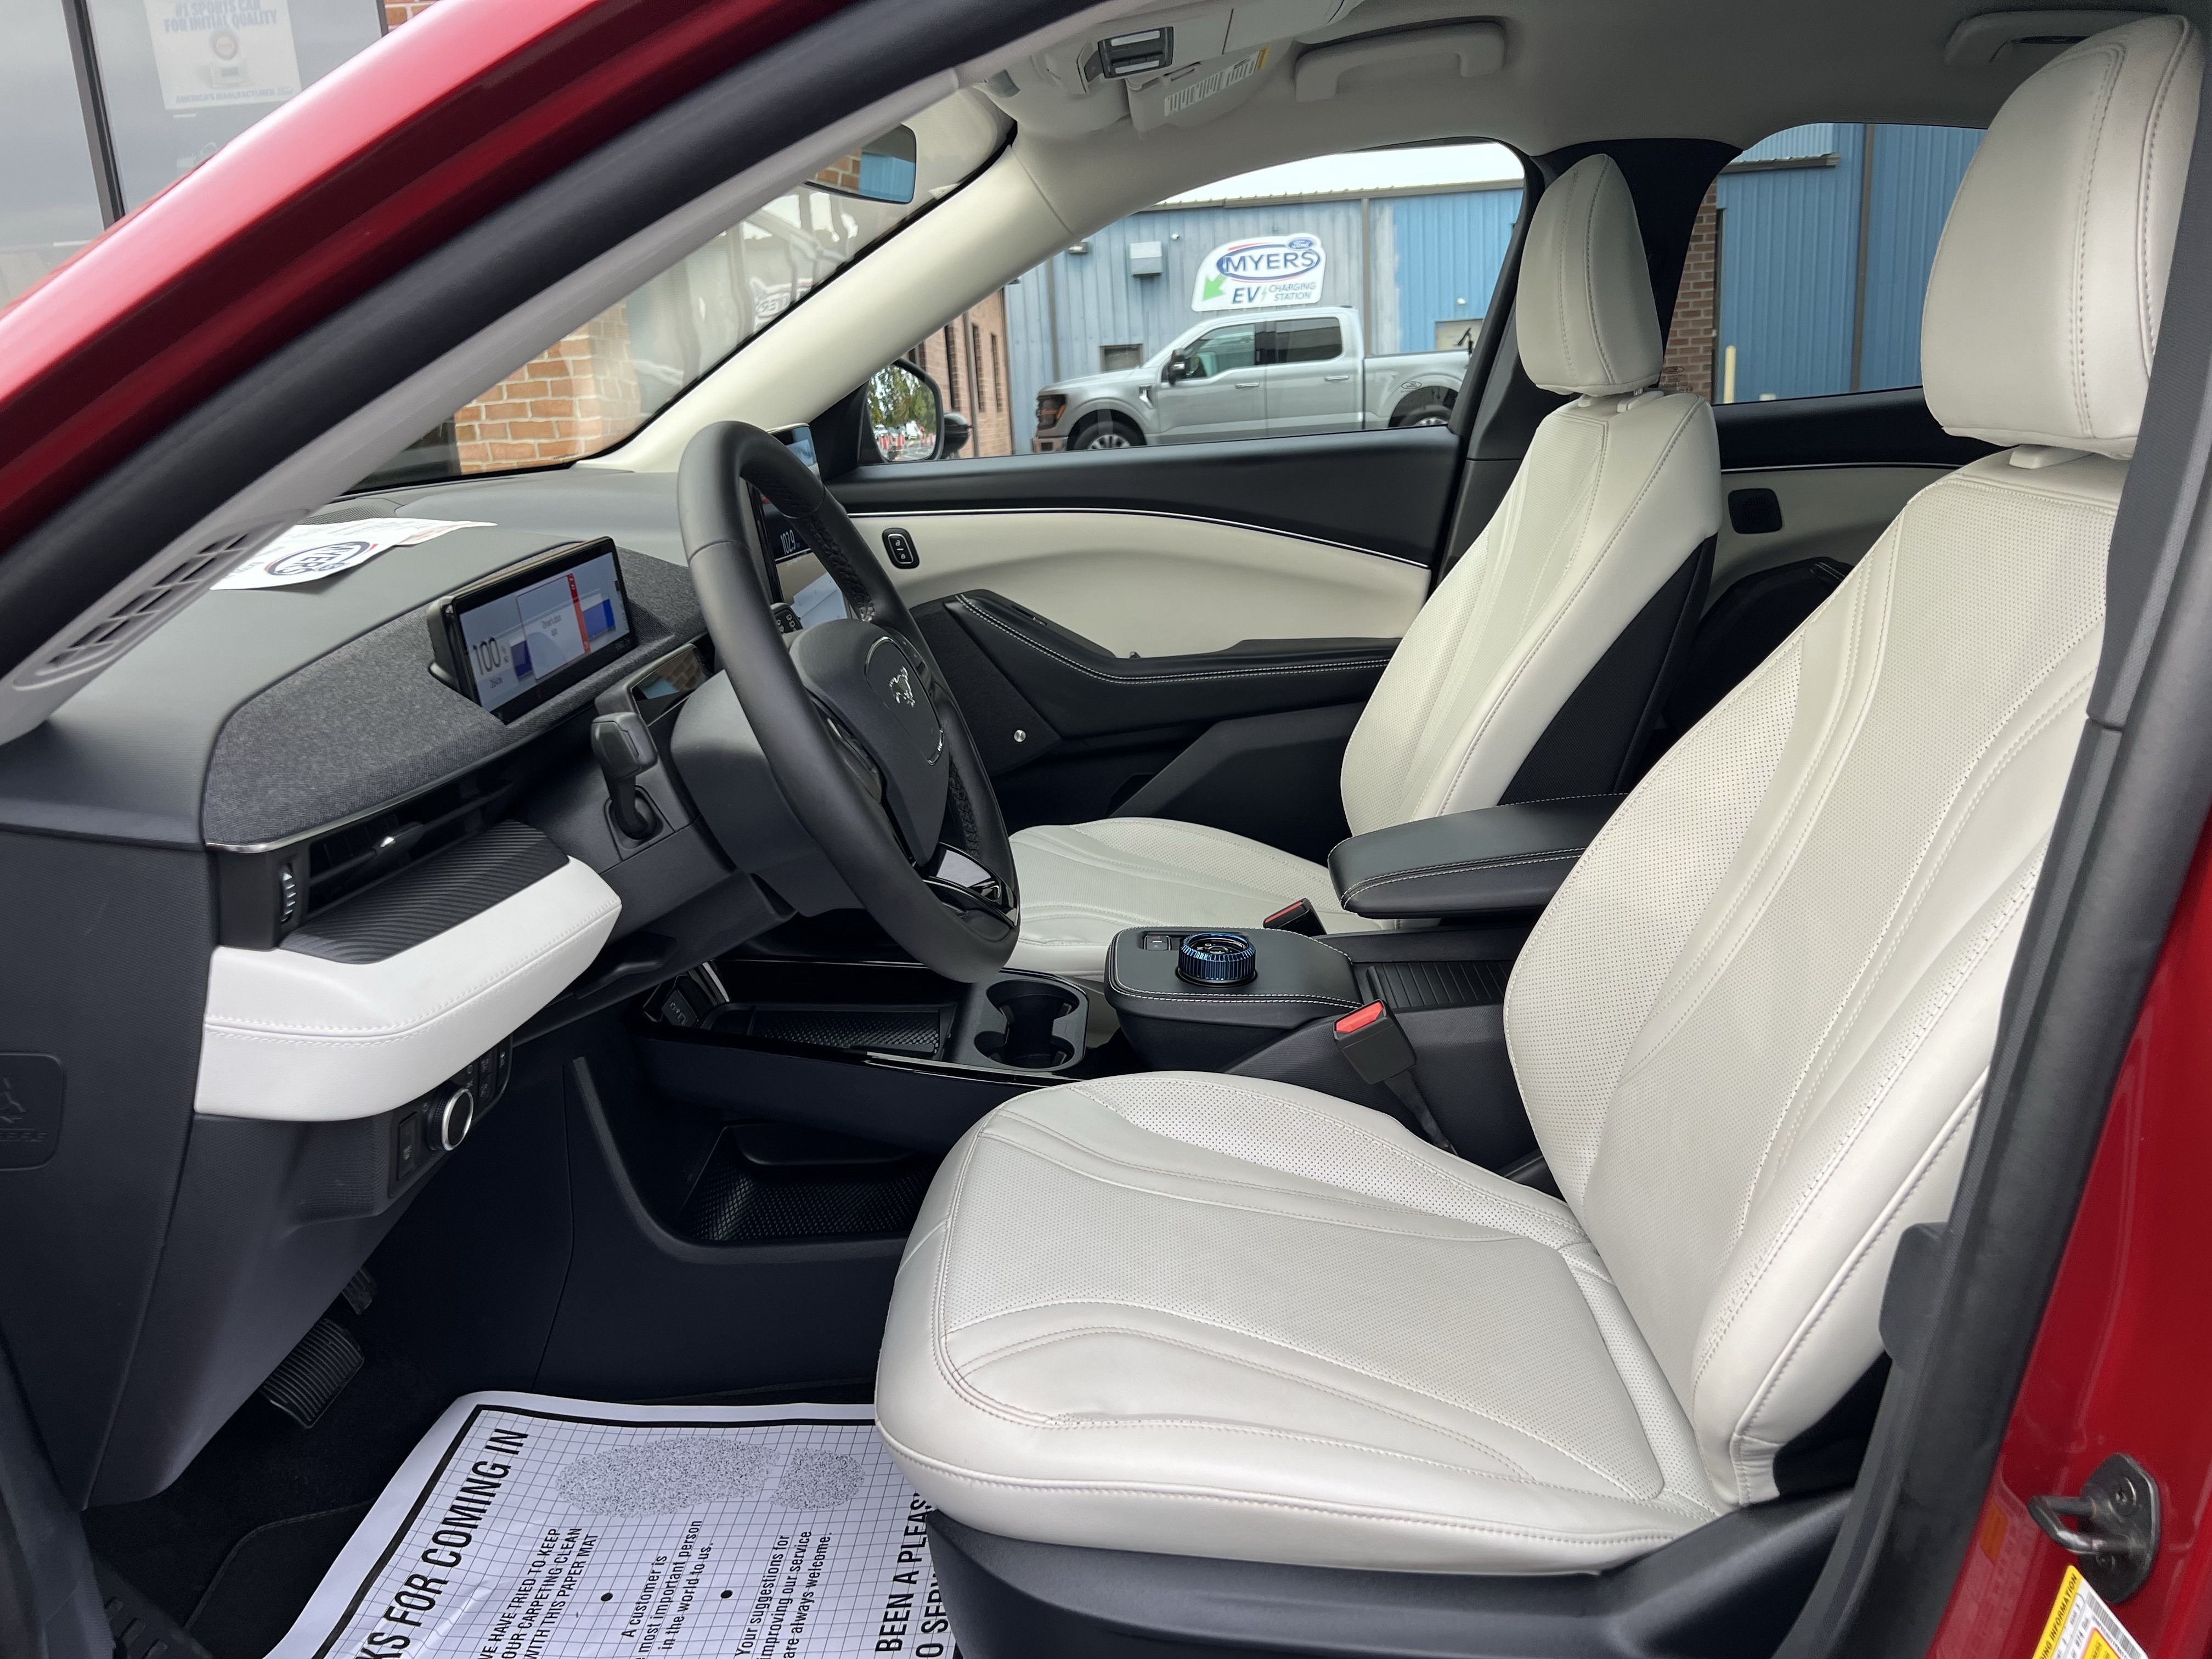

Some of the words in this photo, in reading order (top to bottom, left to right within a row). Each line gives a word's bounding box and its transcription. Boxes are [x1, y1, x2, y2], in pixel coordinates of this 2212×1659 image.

[164, 17, 185, 32] FOR
[232, 9, 277, 29] QUALITY
[1224, 250, 1315, 273] MYERS
[1291, 240, 1311, 249] Ford
[1232, 286, 1261, 304] EV
[1268, 281, 1317, 293] CHARGING
[1274, 292, 1313, 302] STATION
[473, 637, 501, 675] 100
[382, 1574, 449, 1627] FOR
[421, 1461, 511, 1567] COMING
[484, 1428, 529, 1455] IN
[897, 1493, 933, 1563] PLEAS
[690, 1564, 705, 1575] to
[698, 1543, 714, 1560] us.
[782, 1576, 797, 1594] our
[790, 1531, 812, 1572] service
[806, 1532, 832, 1588] welcome.
[488, 1613, 517, 1641] HAVE
[507, 1578, 536, 1610] TRIED
[527, 1560, 546, 1576] TO
[537, 1528, 560, 1556] KEEP
[501, 1633, 527, 1659] OUR
[517, 1568, 563, 1629] CARPETING
[554, 1528, 582, 1563] CLEAN
[524, 1629, 550, 1659] WITH
[540, 1601, 566, 1626] THIS
[556, 1561, 586, 1597] PAPER
[577, 1534, 598, 1556] MAT
[621, 1629, 637, 1638] A
[630, 1570, 661, 1626] customer
[651, 1556, 667, 1566] is
[639, 1623, 661, 1653] most
[650, 1561, 686, 1619] important
[678, 1521, 702, 1557] person
[677, 1578, 699, 1612] world
[734, 1627, 758, 1657] Your
[750, 1553, 784, 1624] suggestions
[772, 1535, 789, 1550] for
[893, 1571, 919, 1585] A
[789, 1592, 815, 1633] always
[875, 1593, 914, 1651] BEEN
[921, 1573, 949, 1633] SER
[2049, 1573, 2077, 1641] INFORMATION
[658, 1638, 676, 1650] in
[665, 1616, 685, 1634] the
[783, 1638, 799, 1659] are
